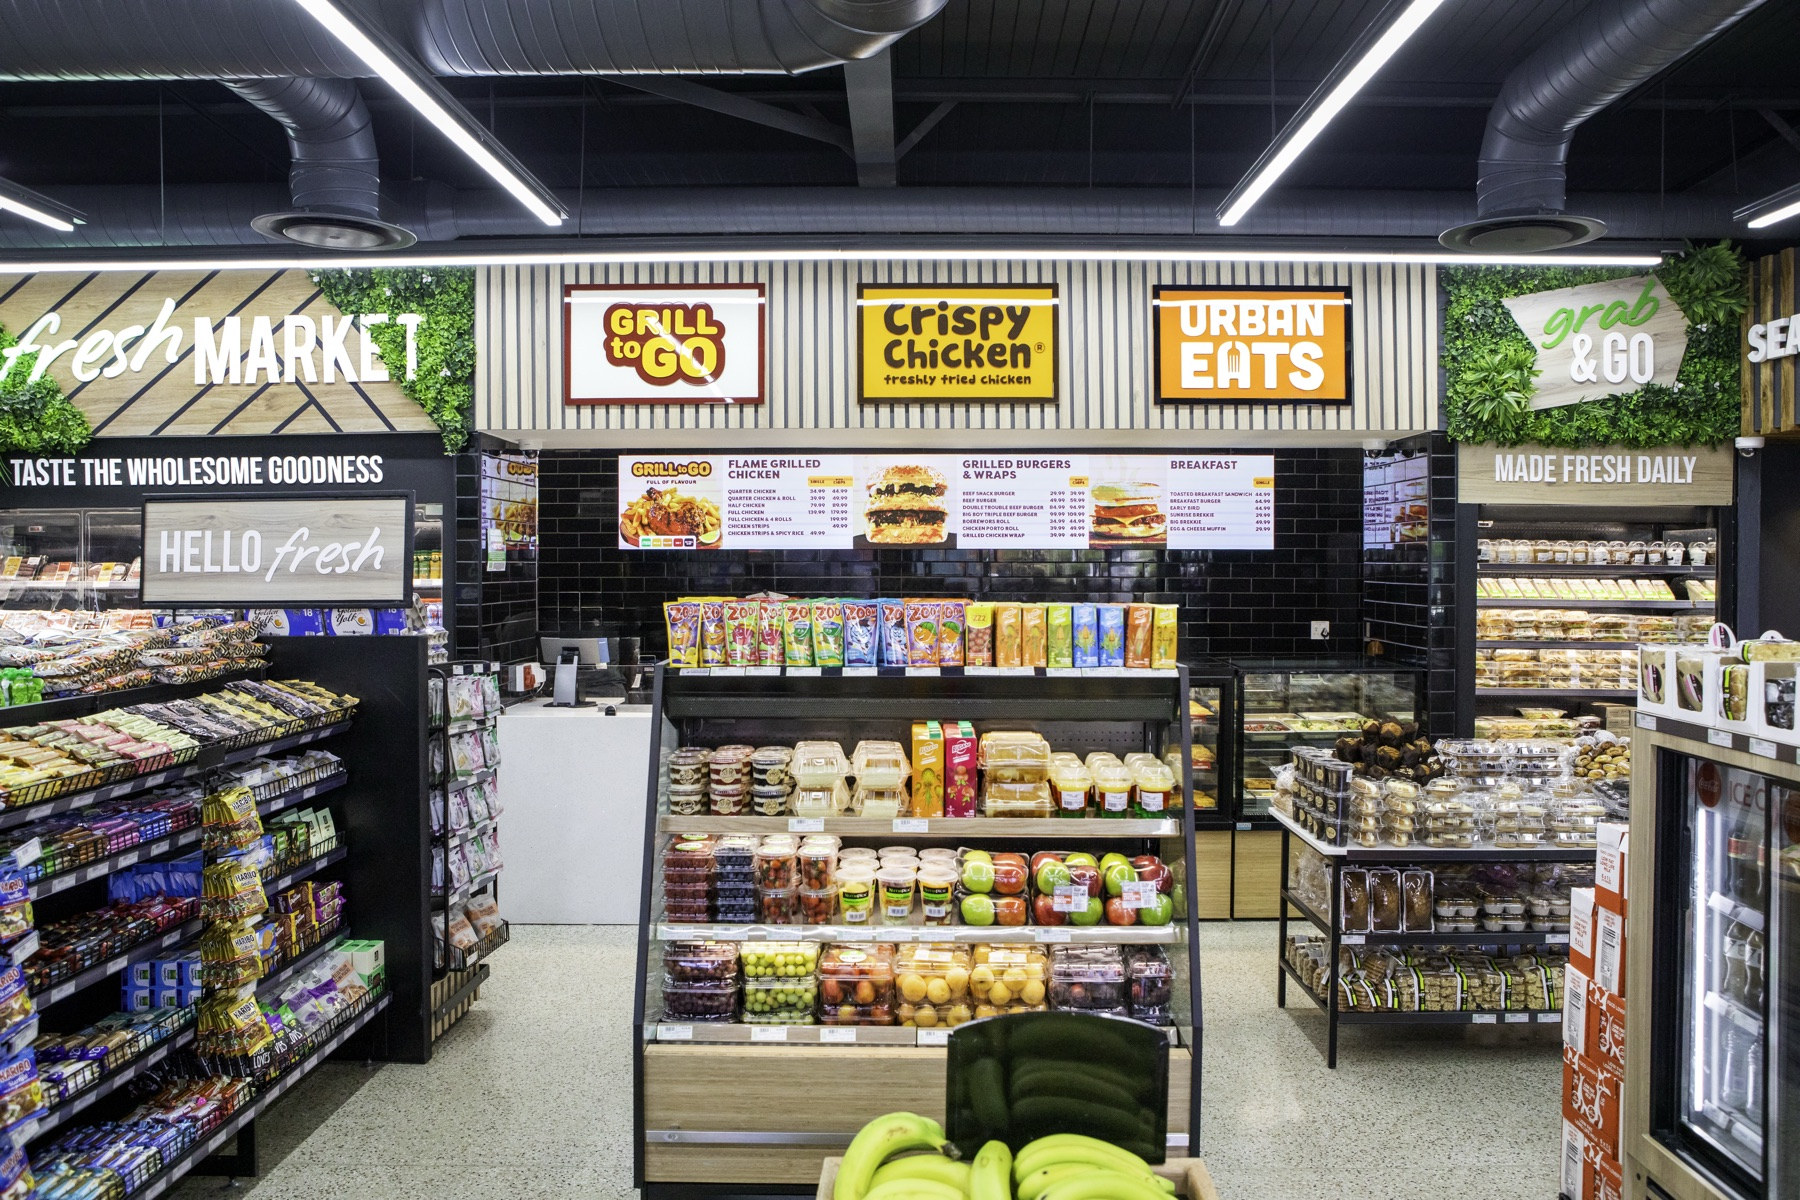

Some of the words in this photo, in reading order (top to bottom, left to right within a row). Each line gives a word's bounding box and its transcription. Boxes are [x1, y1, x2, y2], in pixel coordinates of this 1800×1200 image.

[610, 308, 718, 336] GRILL
[883, 300, 1032, 341] Crispy
[1180, 300, 1325, 337] URBAN
[1541, 278, 1660, 350] grab
[0, 298, 184, 386] fresh
[194, 313, 425, 385] MARKET
[610, 336, 642, 360] to
[641, 336, 718, 378] GO
[1180, 340, 1325, 391] EATS
[883, 374, 937, 386] freshly
[940, 374, 976, 386] fried
[980, 374, 1032, 385] chicken
[10, 457, 76, 487] TASTE
[81, 457, 122, 486] THE
[128, 456, 263, 486] WHOLESOME
[268, 455, 384, 486] GOODNESS
[632, 462, 678, 476] GRILL
[677, 465, 687, 474] to
[687, 461, 712, 476] GO
[728, 459, 768, 469] FLAME
[770, 459, 821, 469] GRILLED
[728, 470, 780, 479] CHICKEN
[962, 459, 1013, 469] GRILLED
[1016, 459, 1071, 469] BURGERS
[963, 470, 972, 479] &
[974, 470, 1017, 479] WRAPS
[1170, 461, 1238, 470] BREAKFAST
[1495, 454, 1556, 483] MADE
[1563, 454, 1631, 484] FRESH
[1638, 456, 1698, 484] DAILY
[160, 530, 262, 574] HELLO
[264, 526, 386, 584] fresh
[303, 608, 313, 616] 18
